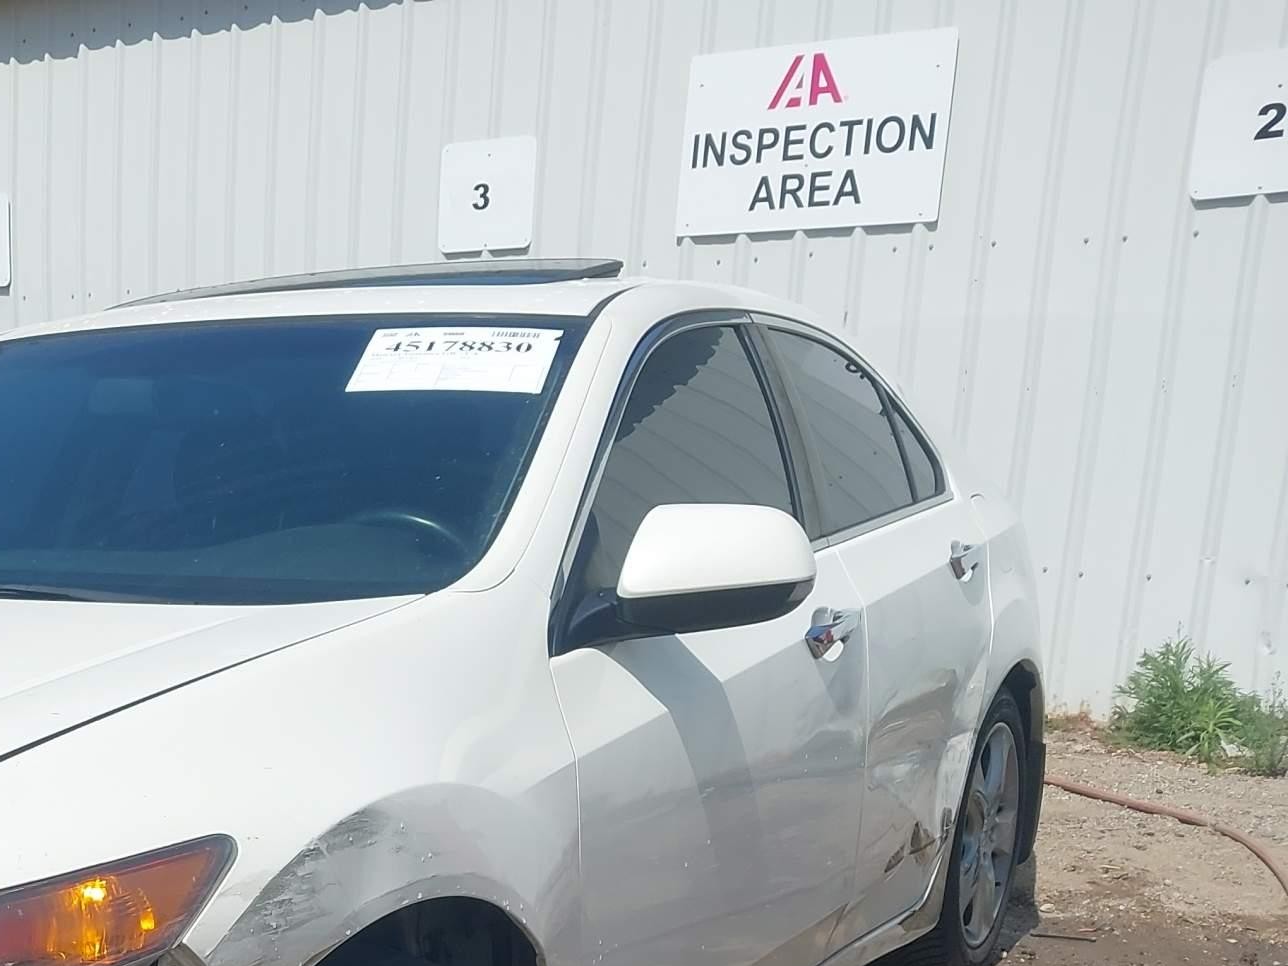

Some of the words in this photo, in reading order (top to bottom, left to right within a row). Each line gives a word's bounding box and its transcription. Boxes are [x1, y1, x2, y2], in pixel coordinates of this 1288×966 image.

[691, 111, 938, 170] INSPECTION
[1253, 101, 1288, 141] 2
[472, 183, 490, 210] 3
[748, 168, 862, 212] AREA
[385, 340, 533, 353] 45178830
